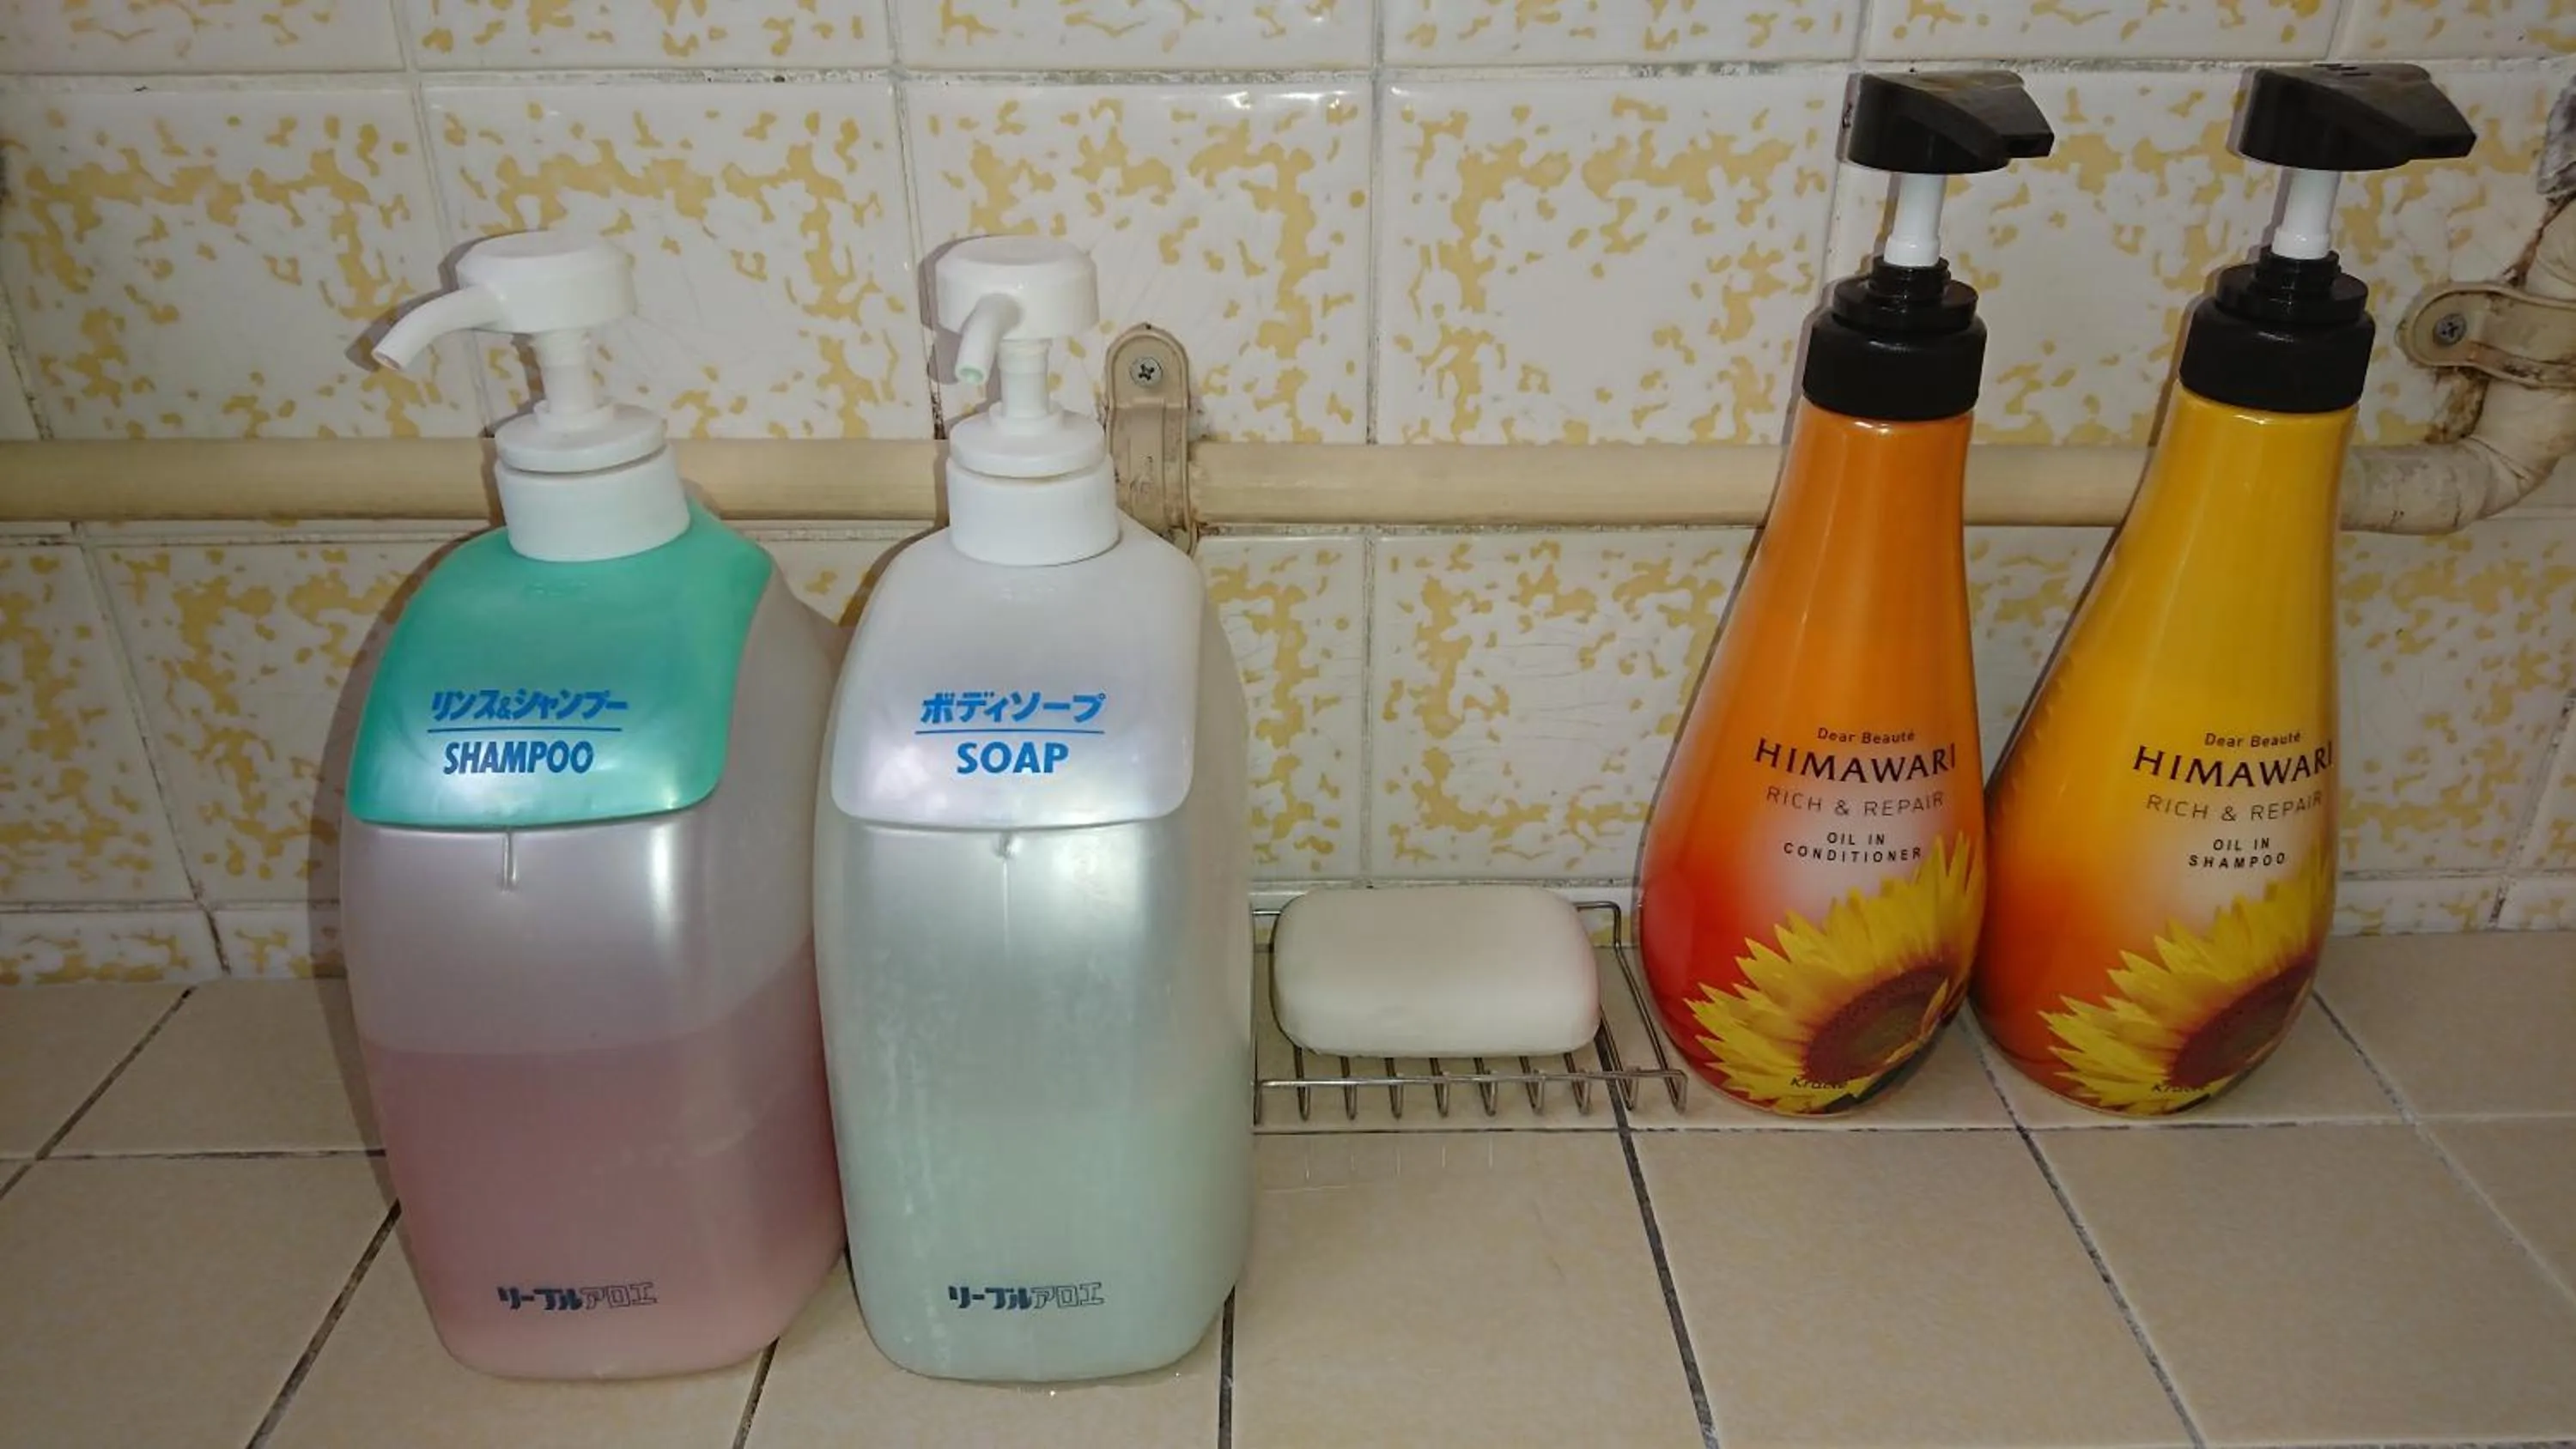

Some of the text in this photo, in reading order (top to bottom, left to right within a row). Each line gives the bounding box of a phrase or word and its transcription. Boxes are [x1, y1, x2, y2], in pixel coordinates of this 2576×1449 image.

[920, 691, 1108, 724] ボディソープ
[1817, 727, 1855, 743] Dear
[2204, 732, 2243, 749] Dear
[443, 740, 595, 774] SHAMPOO
[956, 741, 1070, 773] SOAP
[1754, 737, 1956, 784] HIMAWARI
[2132, 740, 2334, 787] HIMAWARI
[1765, 785, 1944, 815] RICH & REPAIR
[2146, 791, 2323, 822] RICH & REPAIR
[1783, 842, 1923, 863] CONDITIONER
[1826, 832, 1886, 846] OIL IN
[2212, 837, 2271, 852] OIL IN
[2188, 852, 2287, 869] SHAMPOO
